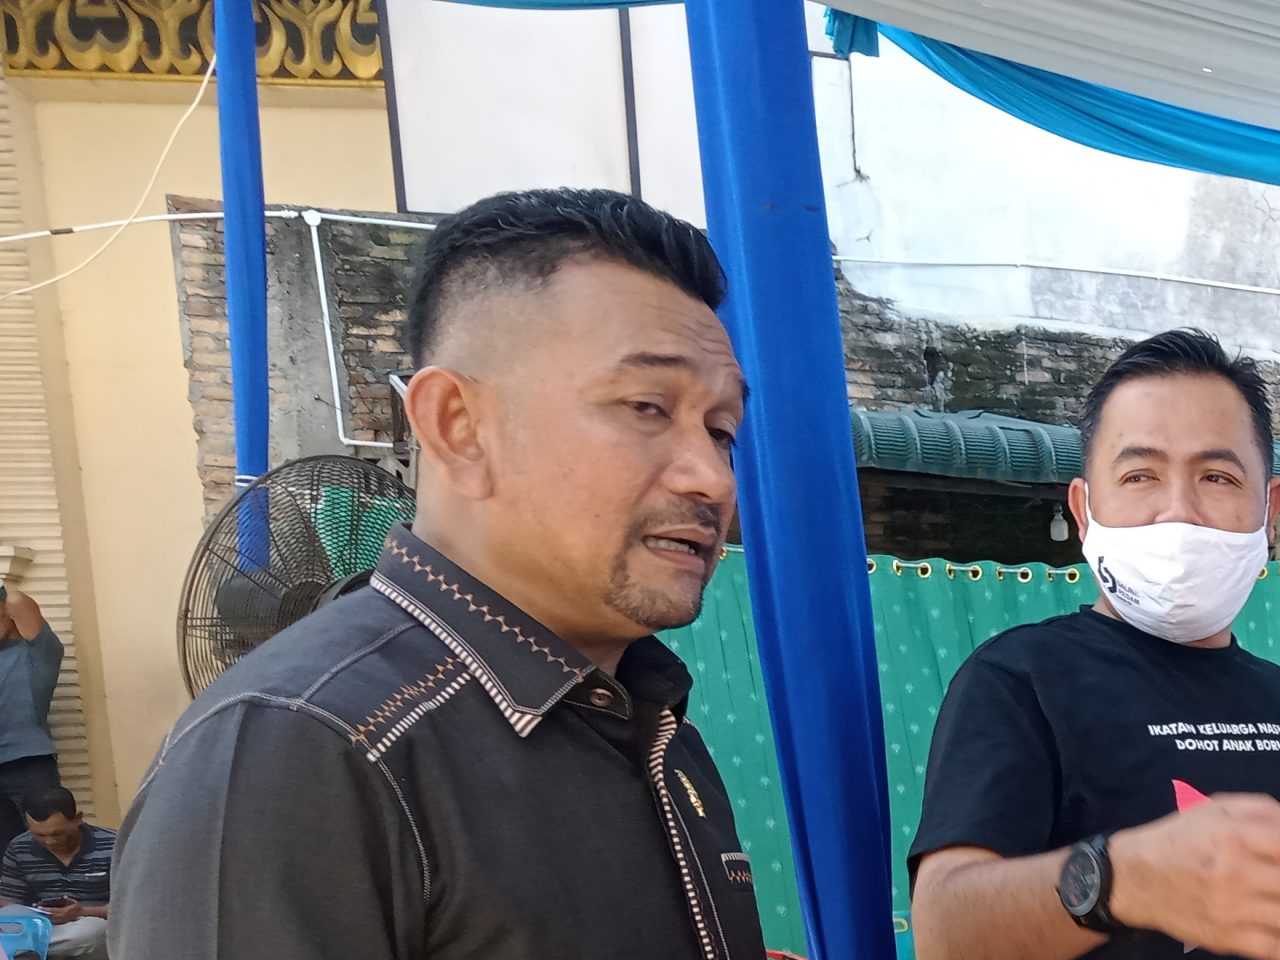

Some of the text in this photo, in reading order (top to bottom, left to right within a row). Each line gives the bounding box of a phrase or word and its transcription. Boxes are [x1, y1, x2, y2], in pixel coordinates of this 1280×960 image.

[1147, 722, 1196, 736] IKATAN
[1197, 722, 1257, 735] KELUARGA
[1175, 738, 1219, 751] DOHOT
[1222, 739, 1255, 751] ANAK
